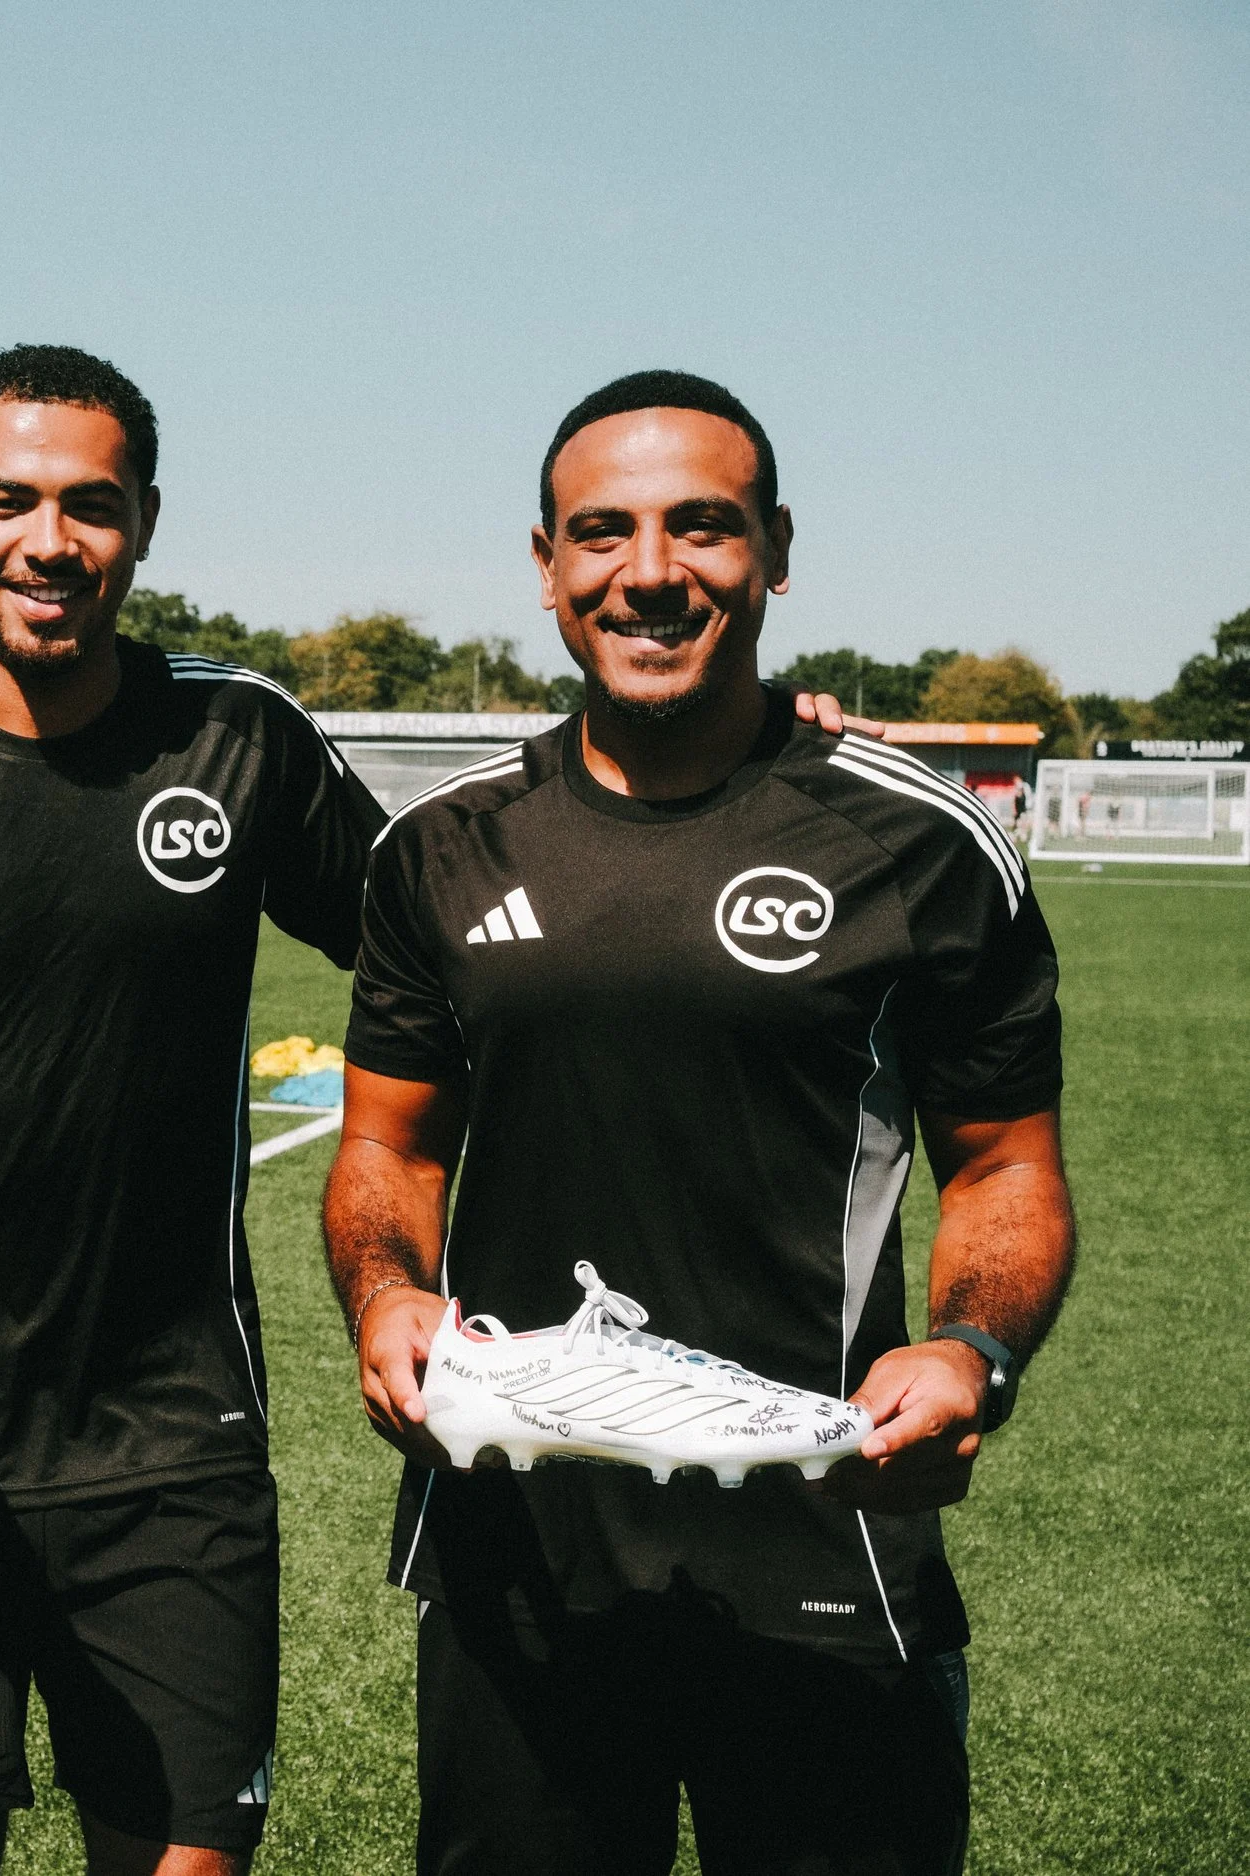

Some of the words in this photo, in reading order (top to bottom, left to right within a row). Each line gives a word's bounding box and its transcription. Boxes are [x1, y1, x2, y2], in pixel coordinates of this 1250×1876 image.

[150, 819, 227, 859] LSC
[729, 896, 827, 941] LSC
[440, 1357, 483, 1385] Aiden
[502, 1367, 551, 1391] PREDATOR
[511, 1404, 554, 1431] Nathan
[814, 1418, 857, 1447] NOAH
[801, 1601, 856, 1614] AEROREADY
